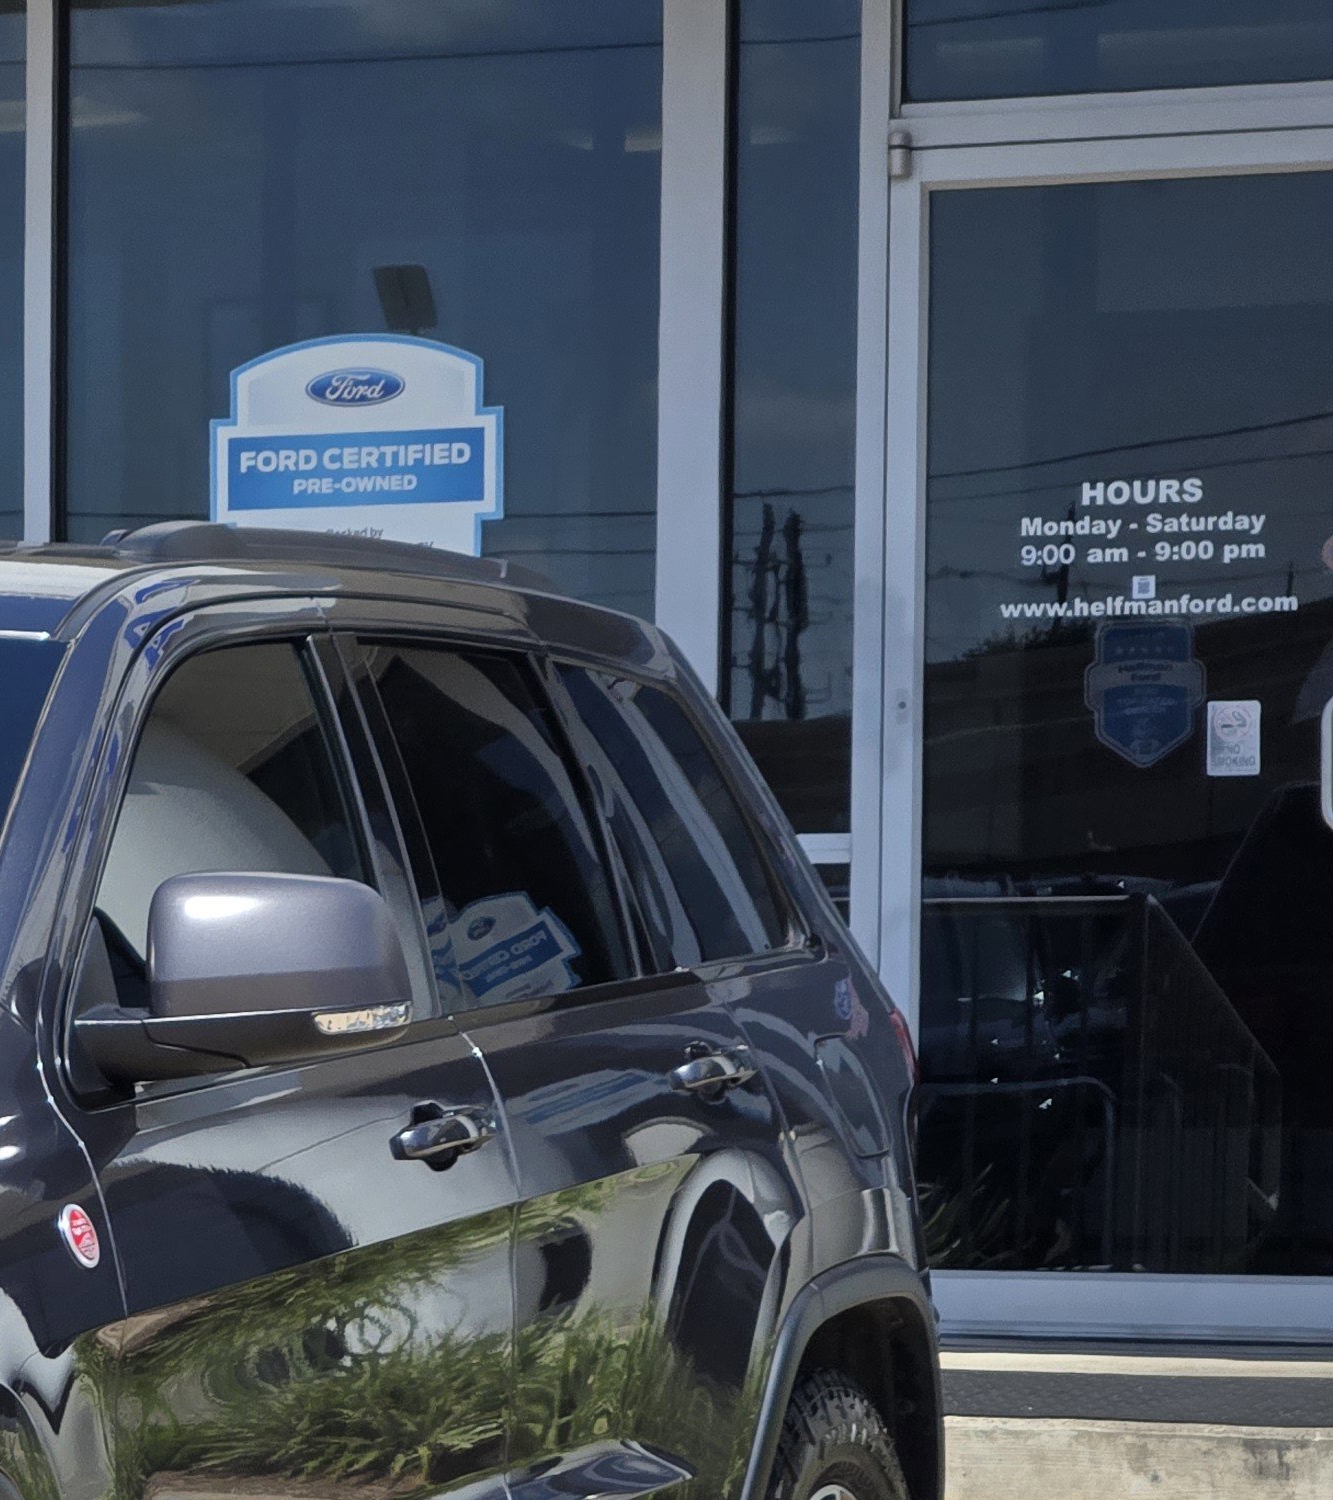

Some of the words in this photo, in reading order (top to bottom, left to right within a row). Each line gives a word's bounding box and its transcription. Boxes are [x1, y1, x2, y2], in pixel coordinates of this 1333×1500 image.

[324, 373, 384, 401] Ford
[239, 449, 318, 474] FORD
[322, 442, 471, 469] CERTIFIED
[293, 474, 417, 495] PRE-OWNED
[1081, 478, 1204, 506] HOURS
[1020, 516, 1122, 539] Monday
[1146, 512, 1266, 535] Saturday
[1021, 543, 1076, 566] 9:00
[1087, 545, 1129, 564] am
[1155, 540, 1214, 562] 9:00
[1223, 541, 1266, 564] pm
[1000, 593, 1298, 618] www.helfmanford.com
